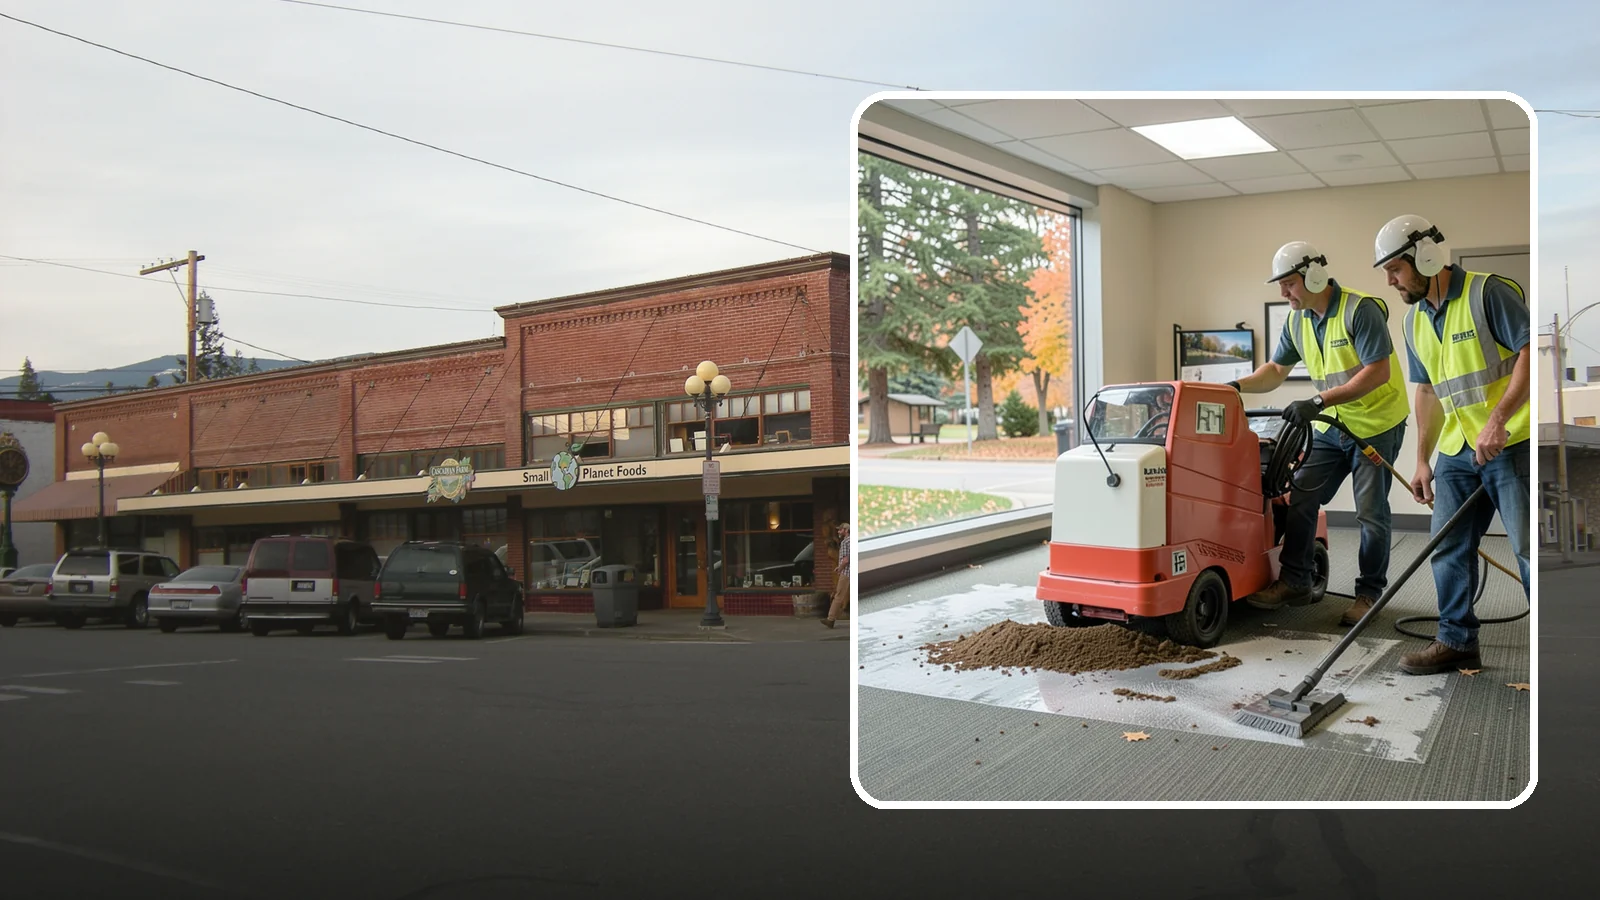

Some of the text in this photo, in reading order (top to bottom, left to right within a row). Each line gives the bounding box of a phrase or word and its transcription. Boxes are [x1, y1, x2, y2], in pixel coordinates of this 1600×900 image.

[523, 464, 647, 482] Small Planet Foods
